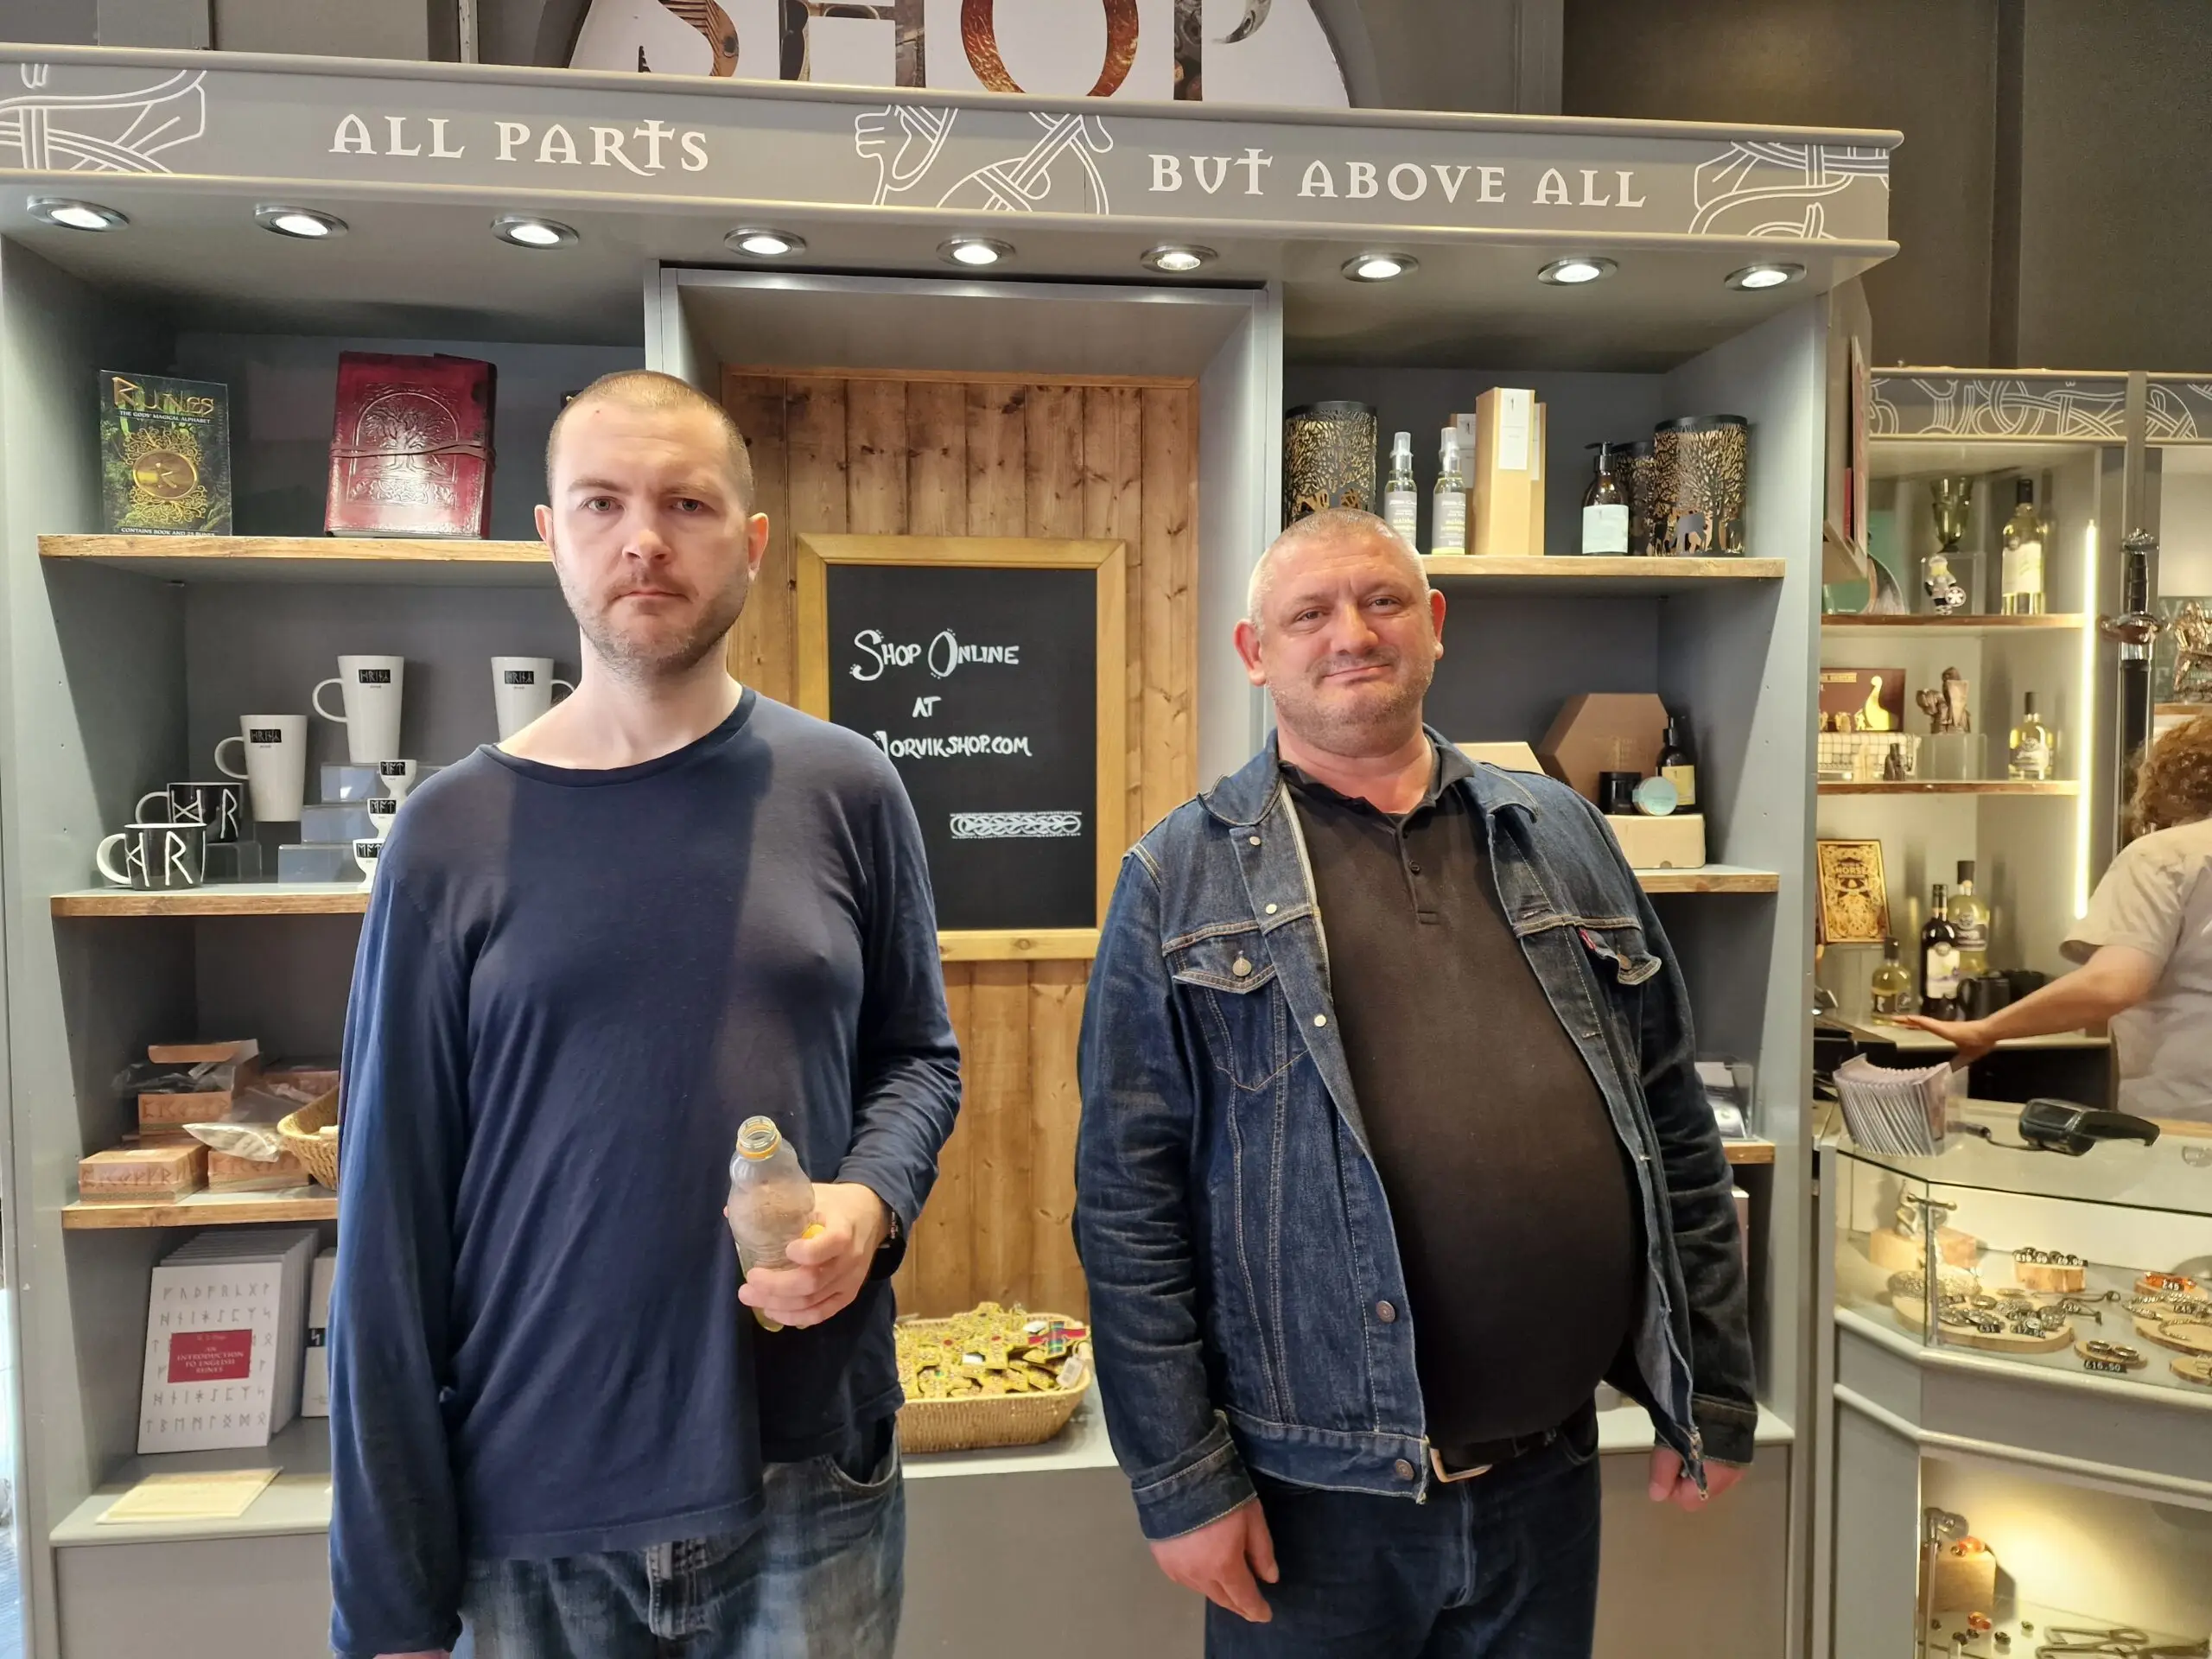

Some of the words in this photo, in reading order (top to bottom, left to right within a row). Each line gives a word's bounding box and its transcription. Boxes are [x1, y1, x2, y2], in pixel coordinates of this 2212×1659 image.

[328, 113, 466, 159] ALL
[495, 119, 709, 176] PARTS
[1147, 148, 1274, 195] BUT
[1297, 160, 1506, 203] ABOVE
[1532, 168, 1646, 207] ALL
[111, 377, 214, 416] RUNES
[912, 696, 942, 717] AT
[177, 1351, 245, 1361] INTRODUCTION
